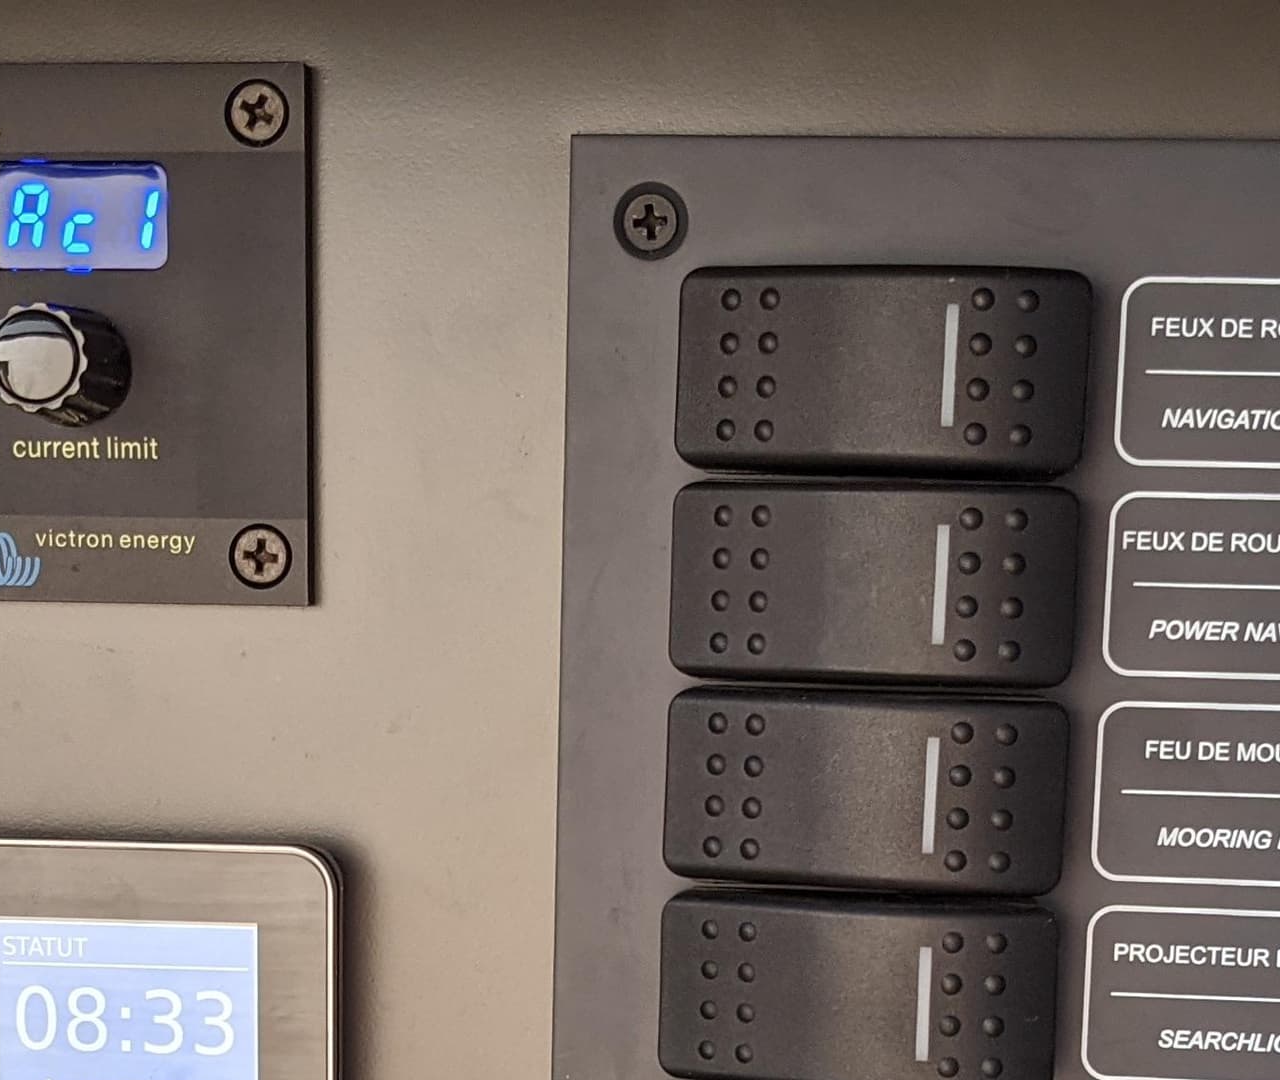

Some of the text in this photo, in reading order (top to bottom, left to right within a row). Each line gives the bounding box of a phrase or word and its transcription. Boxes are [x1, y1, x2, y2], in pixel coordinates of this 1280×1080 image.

[1151, 316, 1215, 338] FEUX
[1220, 318, 1254, 339] DE
[12, 436, 158, 460] current limit
[35, 528, 196, 554] victron energy
[1122, 530, 1186, 551] FEUX
[1191, 531, 1224, 552] DE
[1148, 619, 1240, 642] POWER
[1145, 739, 1192, 760] FEU
[1197, 741, 1231, 762] DE
[1157, 826, 1273, 850] MOORING
[2, 935, 88, 959] STATUT
[1113, 942, 1270, 968] PROJECTEUR
[14, 984, 236, 1057] 08:33
